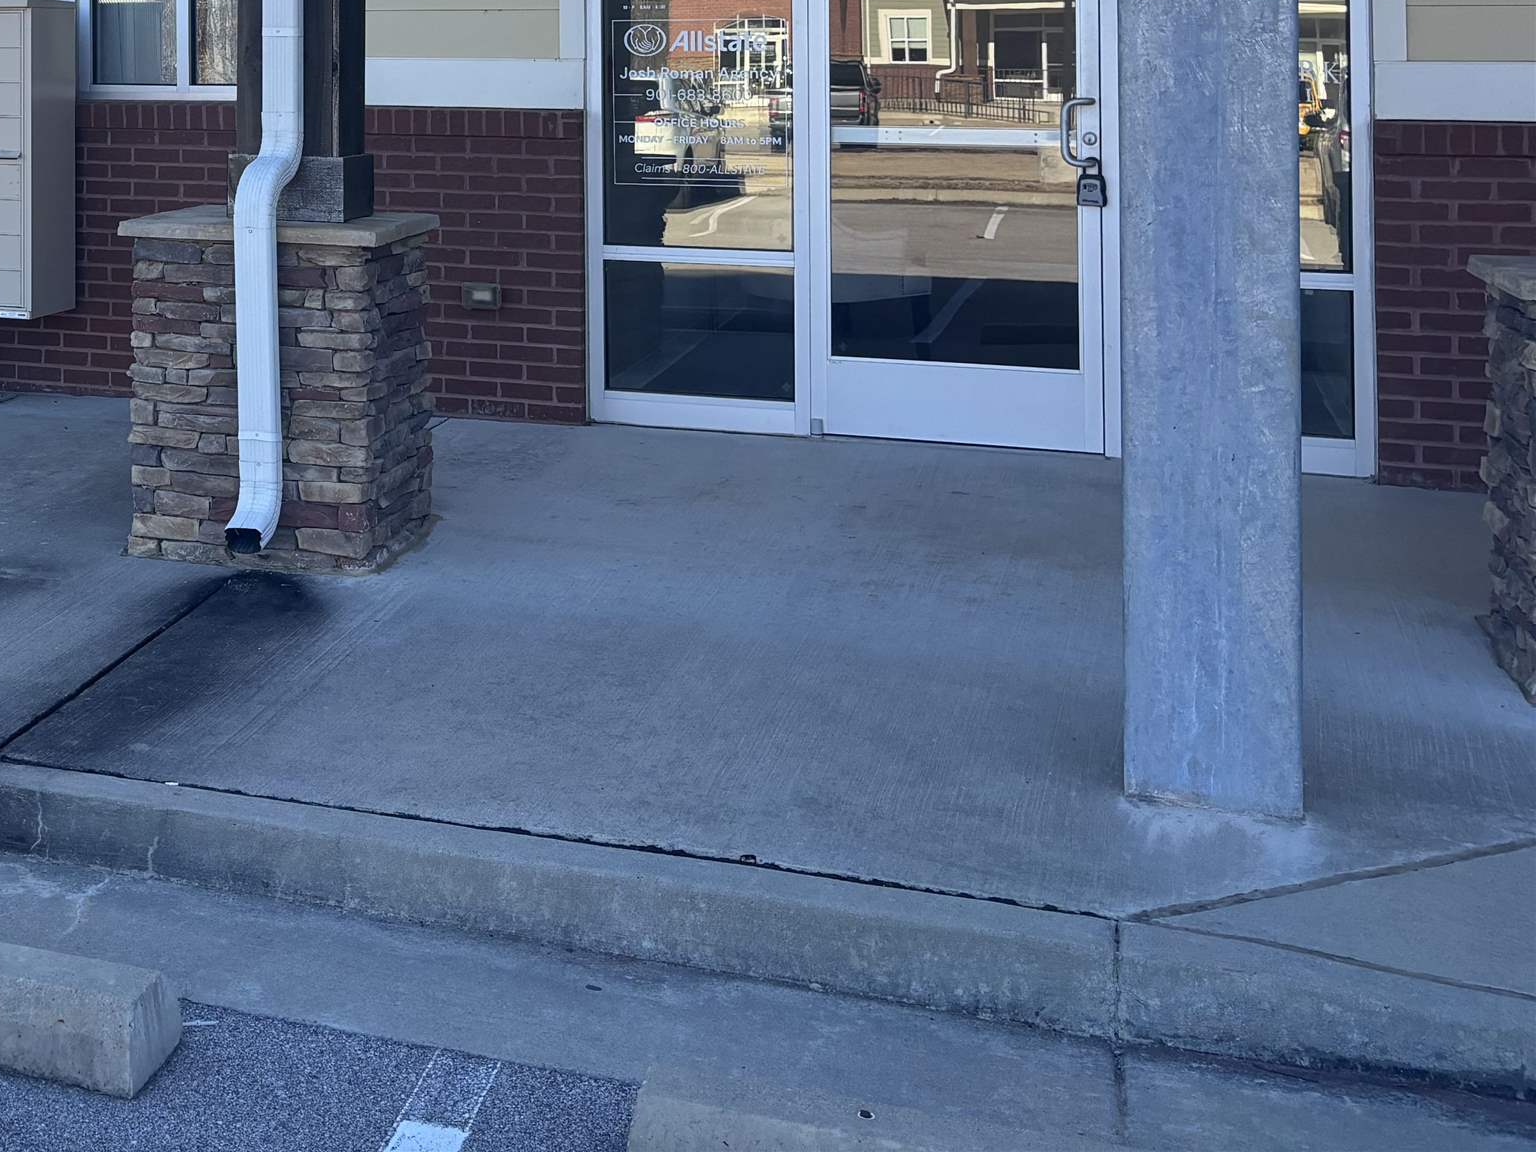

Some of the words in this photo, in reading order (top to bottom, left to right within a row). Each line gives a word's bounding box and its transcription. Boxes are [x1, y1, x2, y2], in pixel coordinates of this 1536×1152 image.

[669, 30, 768, 53] Allstate
[619, 66, 656, 80] Josh
[661, 66, 713, 80] Roman
[719, 66, 779, 83] Agency
[654, 118, 697, 128] OFFICE
[701, 118, 746, 129] HOURS
[618, 134, 665, 145] MONDAY
[673, 135, 709, 145] FRIDAY
[720, 136, 744, 145] 8AM
[746, 137, 757, 145] to
[760, 136, 782, 145] 5PM
[634, 162, 671, 174] Claims
